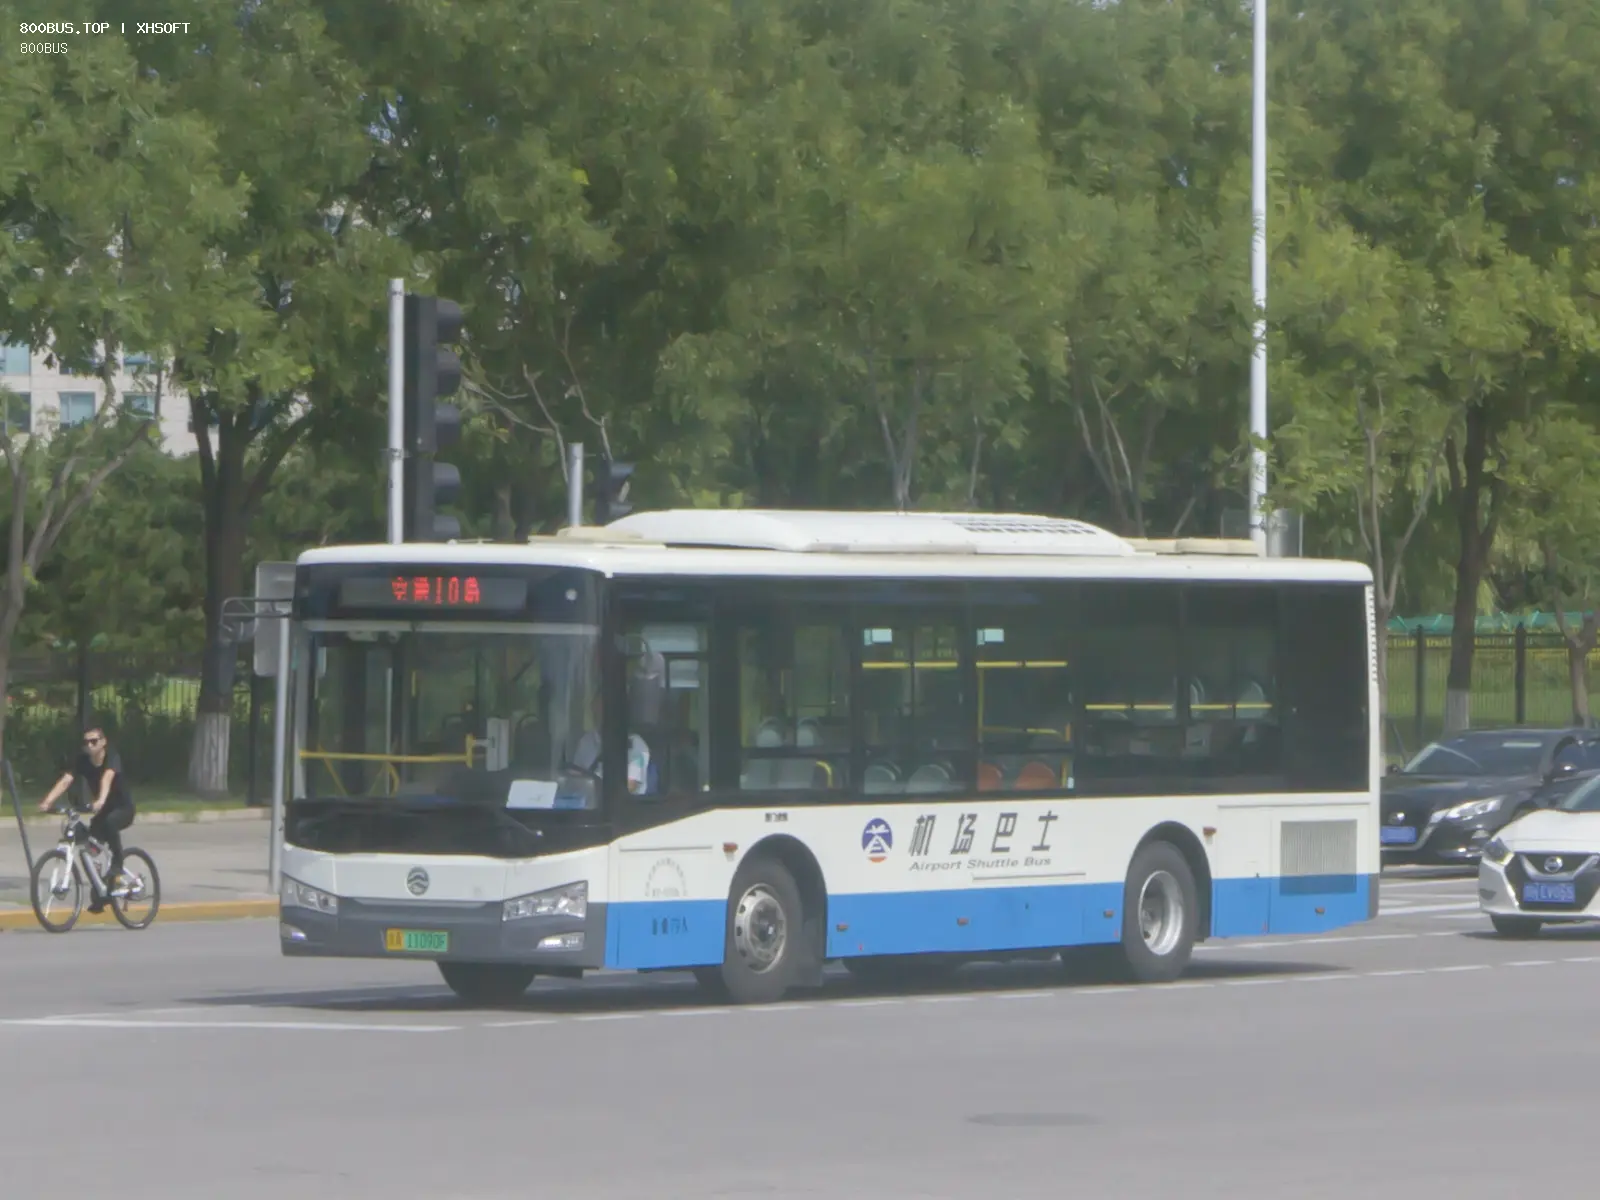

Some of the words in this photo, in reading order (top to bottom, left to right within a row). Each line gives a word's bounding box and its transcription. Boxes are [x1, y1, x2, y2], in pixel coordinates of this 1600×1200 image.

[908, 810, 1059, 856] 机场巴士
[909, 859, 962, 872] Airport
[967, 857, 1019, 869] Shuttle
[1024, 857, 1051, 867] Bus
